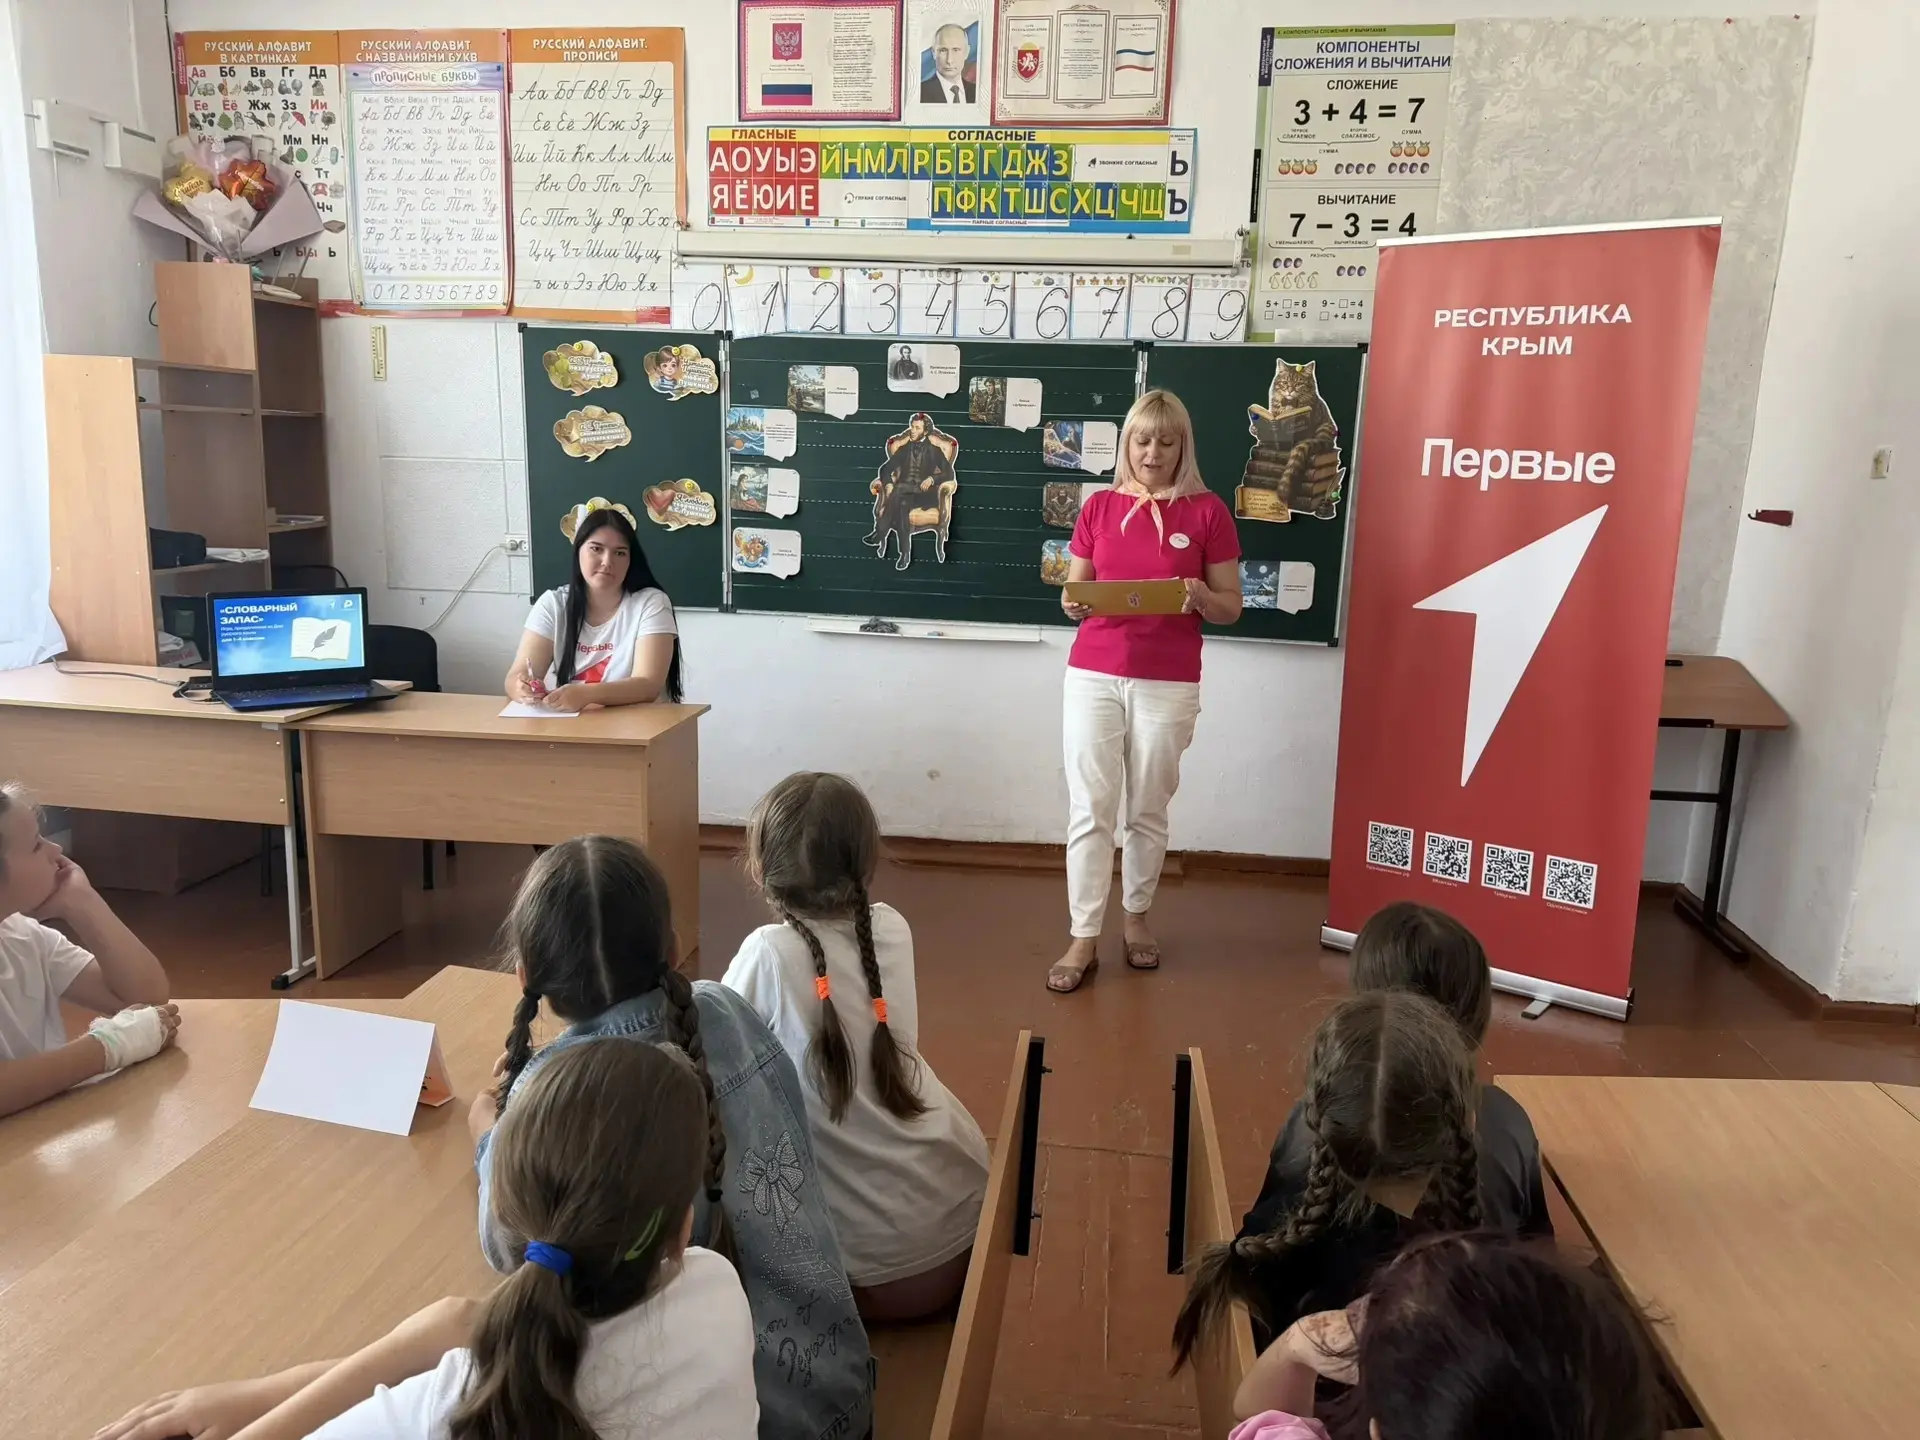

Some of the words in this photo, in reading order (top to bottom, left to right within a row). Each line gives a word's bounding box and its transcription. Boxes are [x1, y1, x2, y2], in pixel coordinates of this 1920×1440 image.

[204, 39, 255, 52] РУССКИЙ
[257, 41, 312, 53] АЛФАВИТ
[361, 39, 411, 51] РУССКИЙ
[415, 40, 471, 51] АЛФАВИТ
[533, 37, 585, 49] РУССКИЙ
[588, 38, 648, 49] АЛФАВИТ.
[1316, 41, 1420, 53] КОМПОНЕНТЫ
[220, 54, 228, 63] В
[231, 53, 298, 64] КАРТИНКАХ
[356, 53, 362, 62] С
[365, 52, 445, 62] НАЗВАНИЯМИ
[449, 52, 478, 62] БУКВ
[564, 51, 618, 61] ПРОПИСИ
[1274, 57, 1354, 70] СЛОЖЕНИЯ
[1357, 57, 1367, 69] И
[1371, 56, 1452, 69] ВЫЧИТАНИ
[191, 67, 207, 78] Аа
[219, 66, 236, 78] Бб
[250, 67, 266, 78] Вв
[281, 67, 295, 78] Гг
[308, 66, 327, 79] Дд
[374, 70, 437, 83] ПРОПИСНЫЕ
[441, 71, 477, 82] БУКВЫ
[1326, 79, 1399, 90] СЛОЖЕНИЕ
[519, 80, 549, 100] Аа
[554, 80, 586, 100] Бб
[583, 80, 609, 100] Вв
[612, 79, 631, 99] Гг
[639, 79, 664, 108] Дд
[194, 100, 209, 111] Ее
[222, 98, 238, 111] Ёё
[248, 99, 271, 111] Жж
[281, 99, 297, 111] Зз
[311, 99, 328, 110] Ии
[1294, 99, 1311, 125] 3
[1349, 99, 1368, 124] 4
[1408, 98, 1426, 123] 7
[533, 112, 551, 131] Ее
[556, 109, 575, 131] Ёё
[582, 111, 625, 131] Жж
[630, 111, 650, 140] Зз
[283, 134, 302, 145] Мм
[312, 134, 329, 145] Нн
[731, 129, 797, 140] ГЛАСНЫЕ
[948, 130, 1036, 142] СОГЛАСНЫЕ
[513, 143, 538, 163] Ии
[542, 140, 567, 163] Йй
[571, 143, 595, 163] Кк
[599, 143, 630, 163] Лл
[633, 143, 674, 163] Мм
[1171, 151, 1188, 176] Ь
[315, 168, 329, 179] Тт
[535, 173, 561, 192] Нн
[567, 173, 587, 192] Оо
[592, 174, 621, 192] Пп
[629, 174, 652, 198] Рр
[1168, 189, 1188, 215] Ъ
[1317, 194, 1396, 205] ВЫЧИТАНИЕ
[317, 202, 333, 213] Чч
[519, 207, 537, 226] Сс
[542, 208, 579, 226] Тт
[584, 207, 602, 234] Уу
[608, 207, 634, 234] Фф
[638, 208, 669, 227] Хх
[1289, 213, 1306, 237] 7
[1343, 212, 1360, 238] 3
[1398, 212, 1417, 237] 4
[528, 239, 556, 262] Цц
[560, 239, 582, 258] Чч
[586, 239, 620, 258] Шш
[624, 240, 662, 264] Щщ
[574, 272, 593, 290] Ээ
[598, 272, 627, 291] Юю
[632, 272, 658, 291] Яя
[692, 282, 722, 331] 0
[762, 281, 779, 333] 1
[810, 282, 839, 331] 2
[867, 283, 896, 333] 3
[925, 283, 951, 334] 4
[979, 284, 1010, 335] 5
[1036, 287, 1069, 339] 6
[1095, 287, 1125, 338] 7
[1152, 287, 1187, 338] 8
[1210, 290, 1246, 340] 9
[1266, 300, 1271, 308] 5
[1301, 300, 1307, 308] 8
[1322, 300, 1328, 308] 9
[1285, 311, 1291, 319] 3
[1301, 311, 1306, 319] 6
[1341, 312, 1347, 320] 4
[1357, 312, 1362, 320] 8
[1434, 304, 1632, 328] РЕСПУБЛИКА
[1481, 336, 1573, 356] КРЫМ
[1421, 438, 1616, 492] Первые
[220, 602, 298, 614] «СЛОВАРНЫЙ
[220, 615, 264, 625] ЗАПАС»
